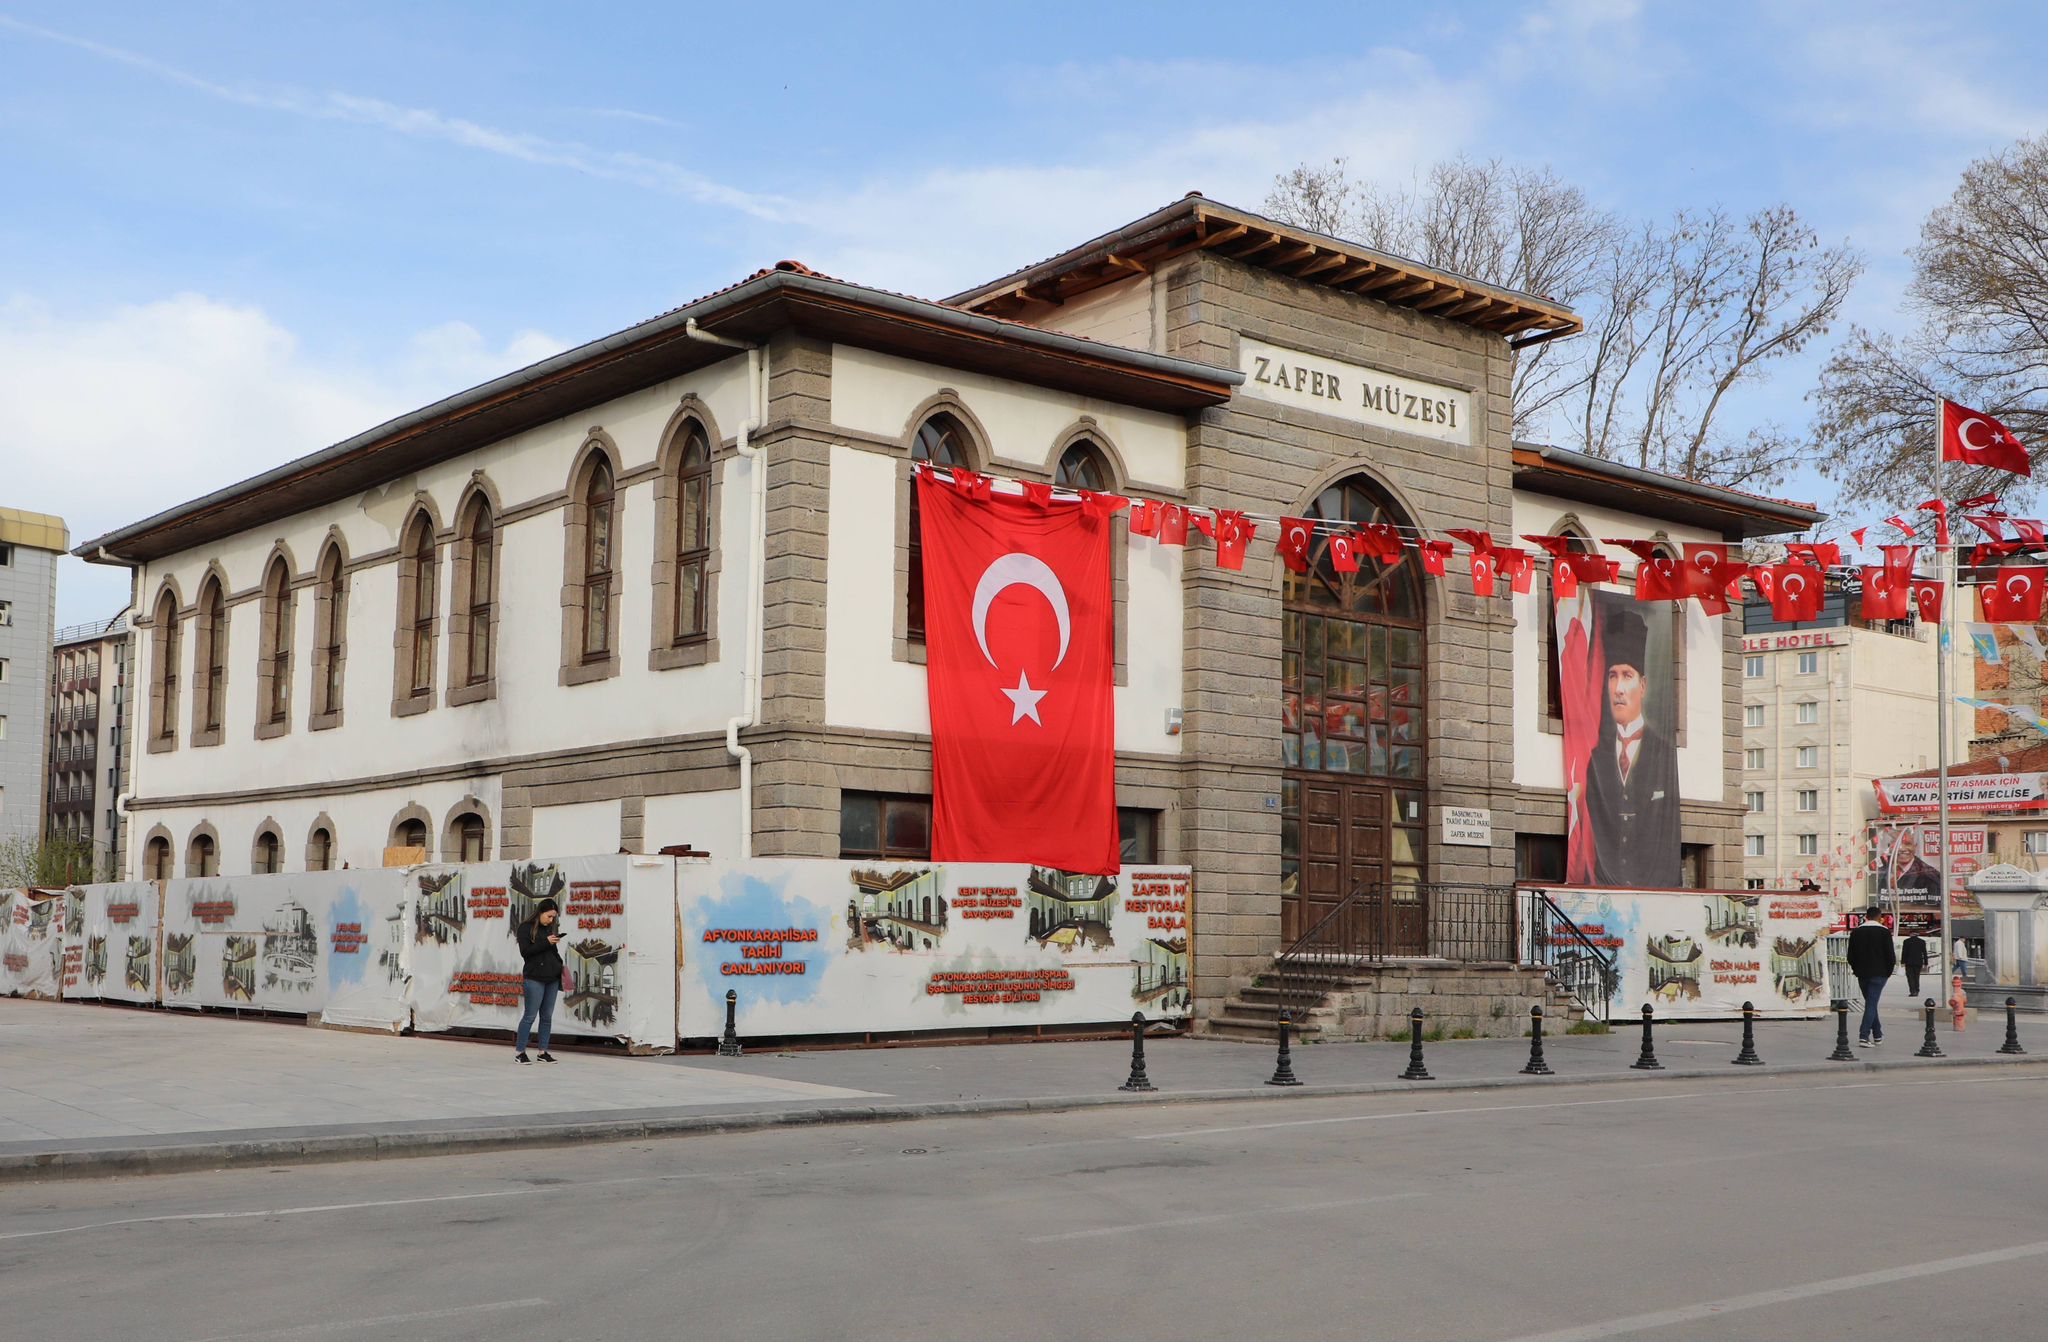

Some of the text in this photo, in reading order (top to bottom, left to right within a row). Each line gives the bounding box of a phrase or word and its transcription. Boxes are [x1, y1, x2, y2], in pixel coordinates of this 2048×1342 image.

[1254, 355, 1457, 428] ZAFER MÜZESİ
[1777, 632, 1834, 648] HOTEL
[1900, 780, 1959, 790] ZORLUKARI
[1961, 778, 1997, 788] AŞMAK
[1891, 788, 2030, 803] VATAN PRTİSİ MECLİSE
[1952, 832, 1982, 842] DEVLET
[1954, 842, 1982, 853] MİLLET
[958, 887, 978, 896] KENT
[1132, 883, 1171, 896] ZAFER
[951, 899, 978, 907] ZAFER
[703, 926, 818, 942] AFYONKARAHİSAR
[741, 943, 782, 959] TARİHİ
[1033, 969, 1069, 981] DÜŞMAN
